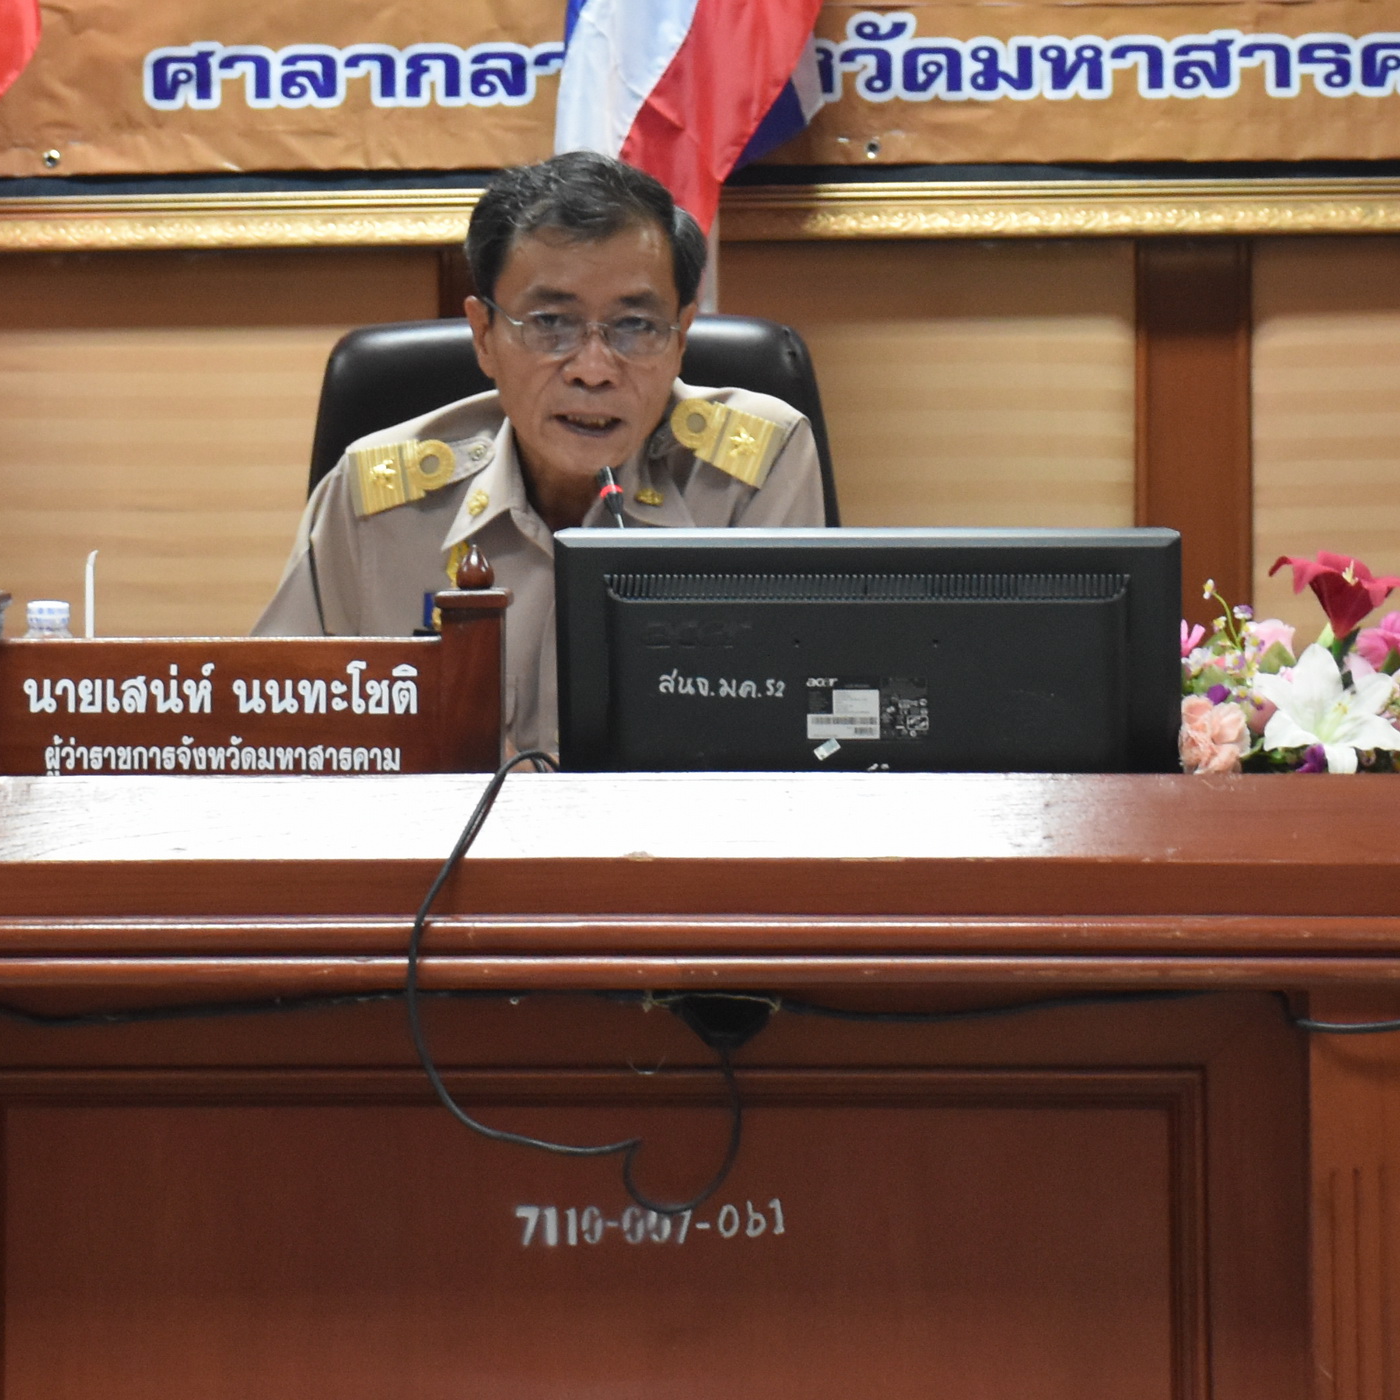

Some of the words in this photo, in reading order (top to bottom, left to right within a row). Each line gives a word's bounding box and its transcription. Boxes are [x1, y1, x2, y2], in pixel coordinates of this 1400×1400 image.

[23, 663, 214, 715] นายเสน่ห์
[233, 661, 419, 716] นนทะโชติ
[45, 735, 401, 776] ผู้ว่าราชการจังหวัดมหาสารคาม
